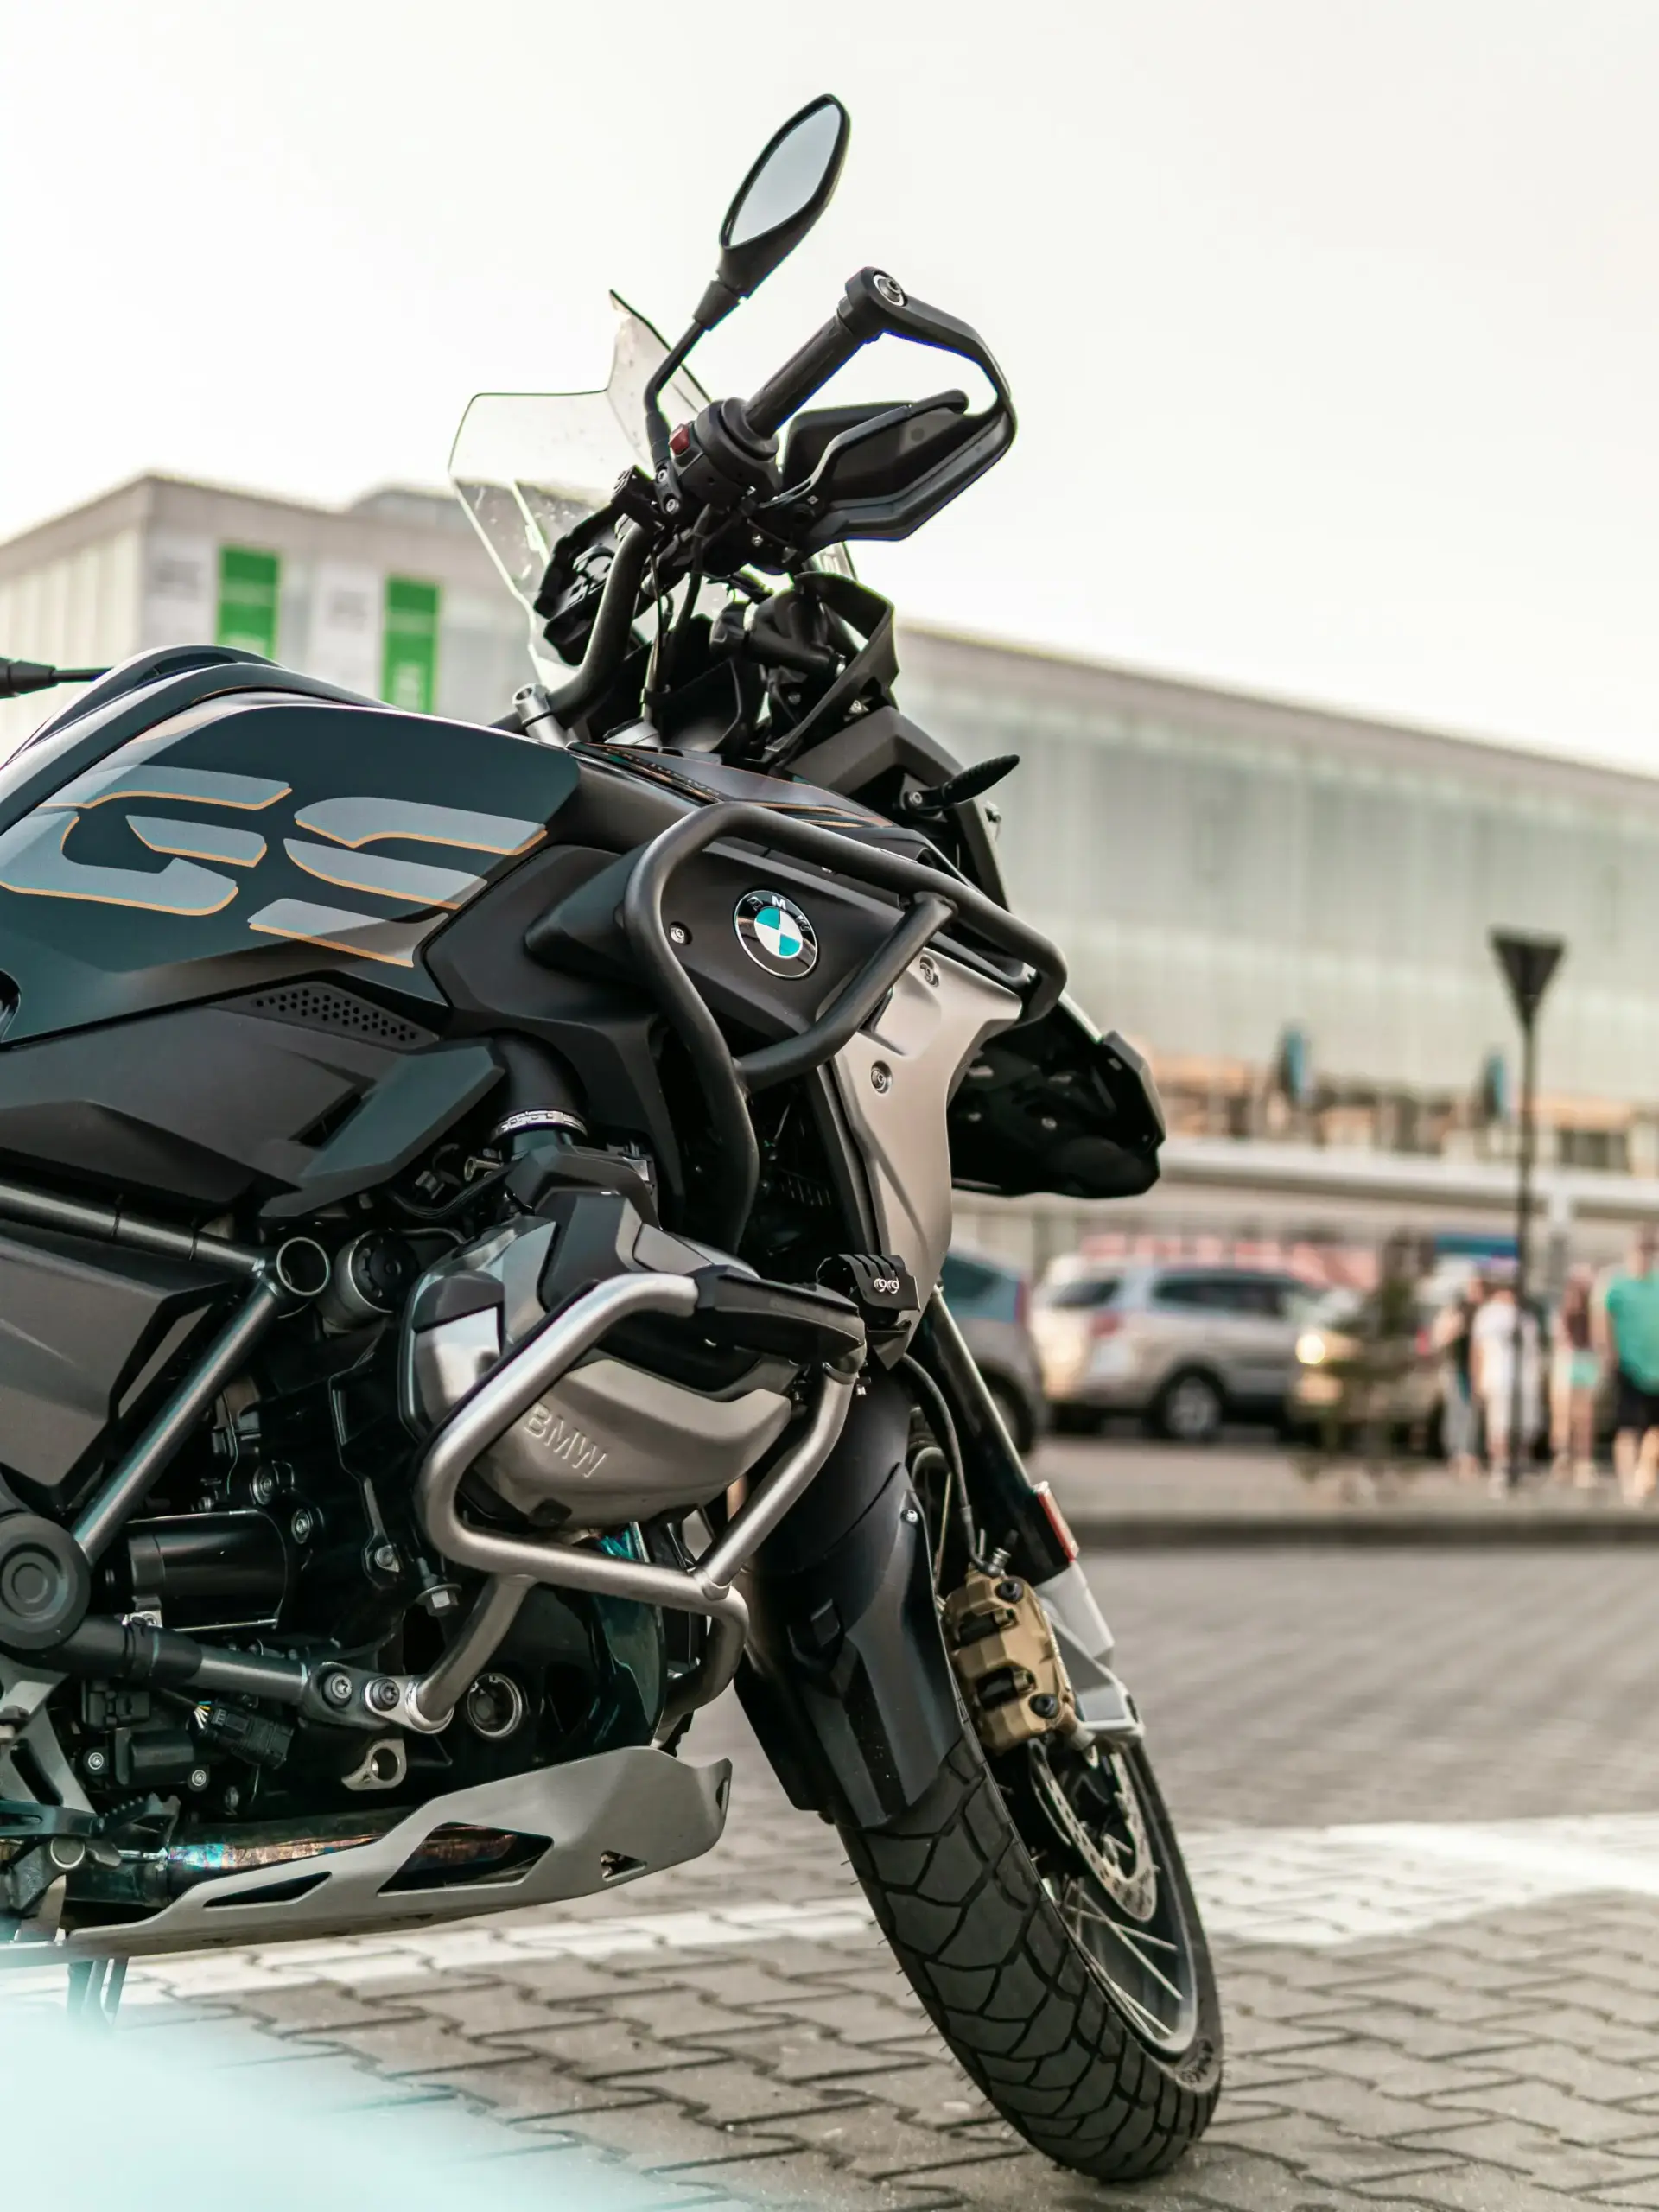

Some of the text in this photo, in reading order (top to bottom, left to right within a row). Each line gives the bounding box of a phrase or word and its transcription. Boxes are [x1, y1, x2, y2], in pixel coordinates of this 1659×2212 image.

[0, 764, 548, 968] GS
[746, 894, 811, 931] BMW
[523, 1403, 607, 1478] BMW
